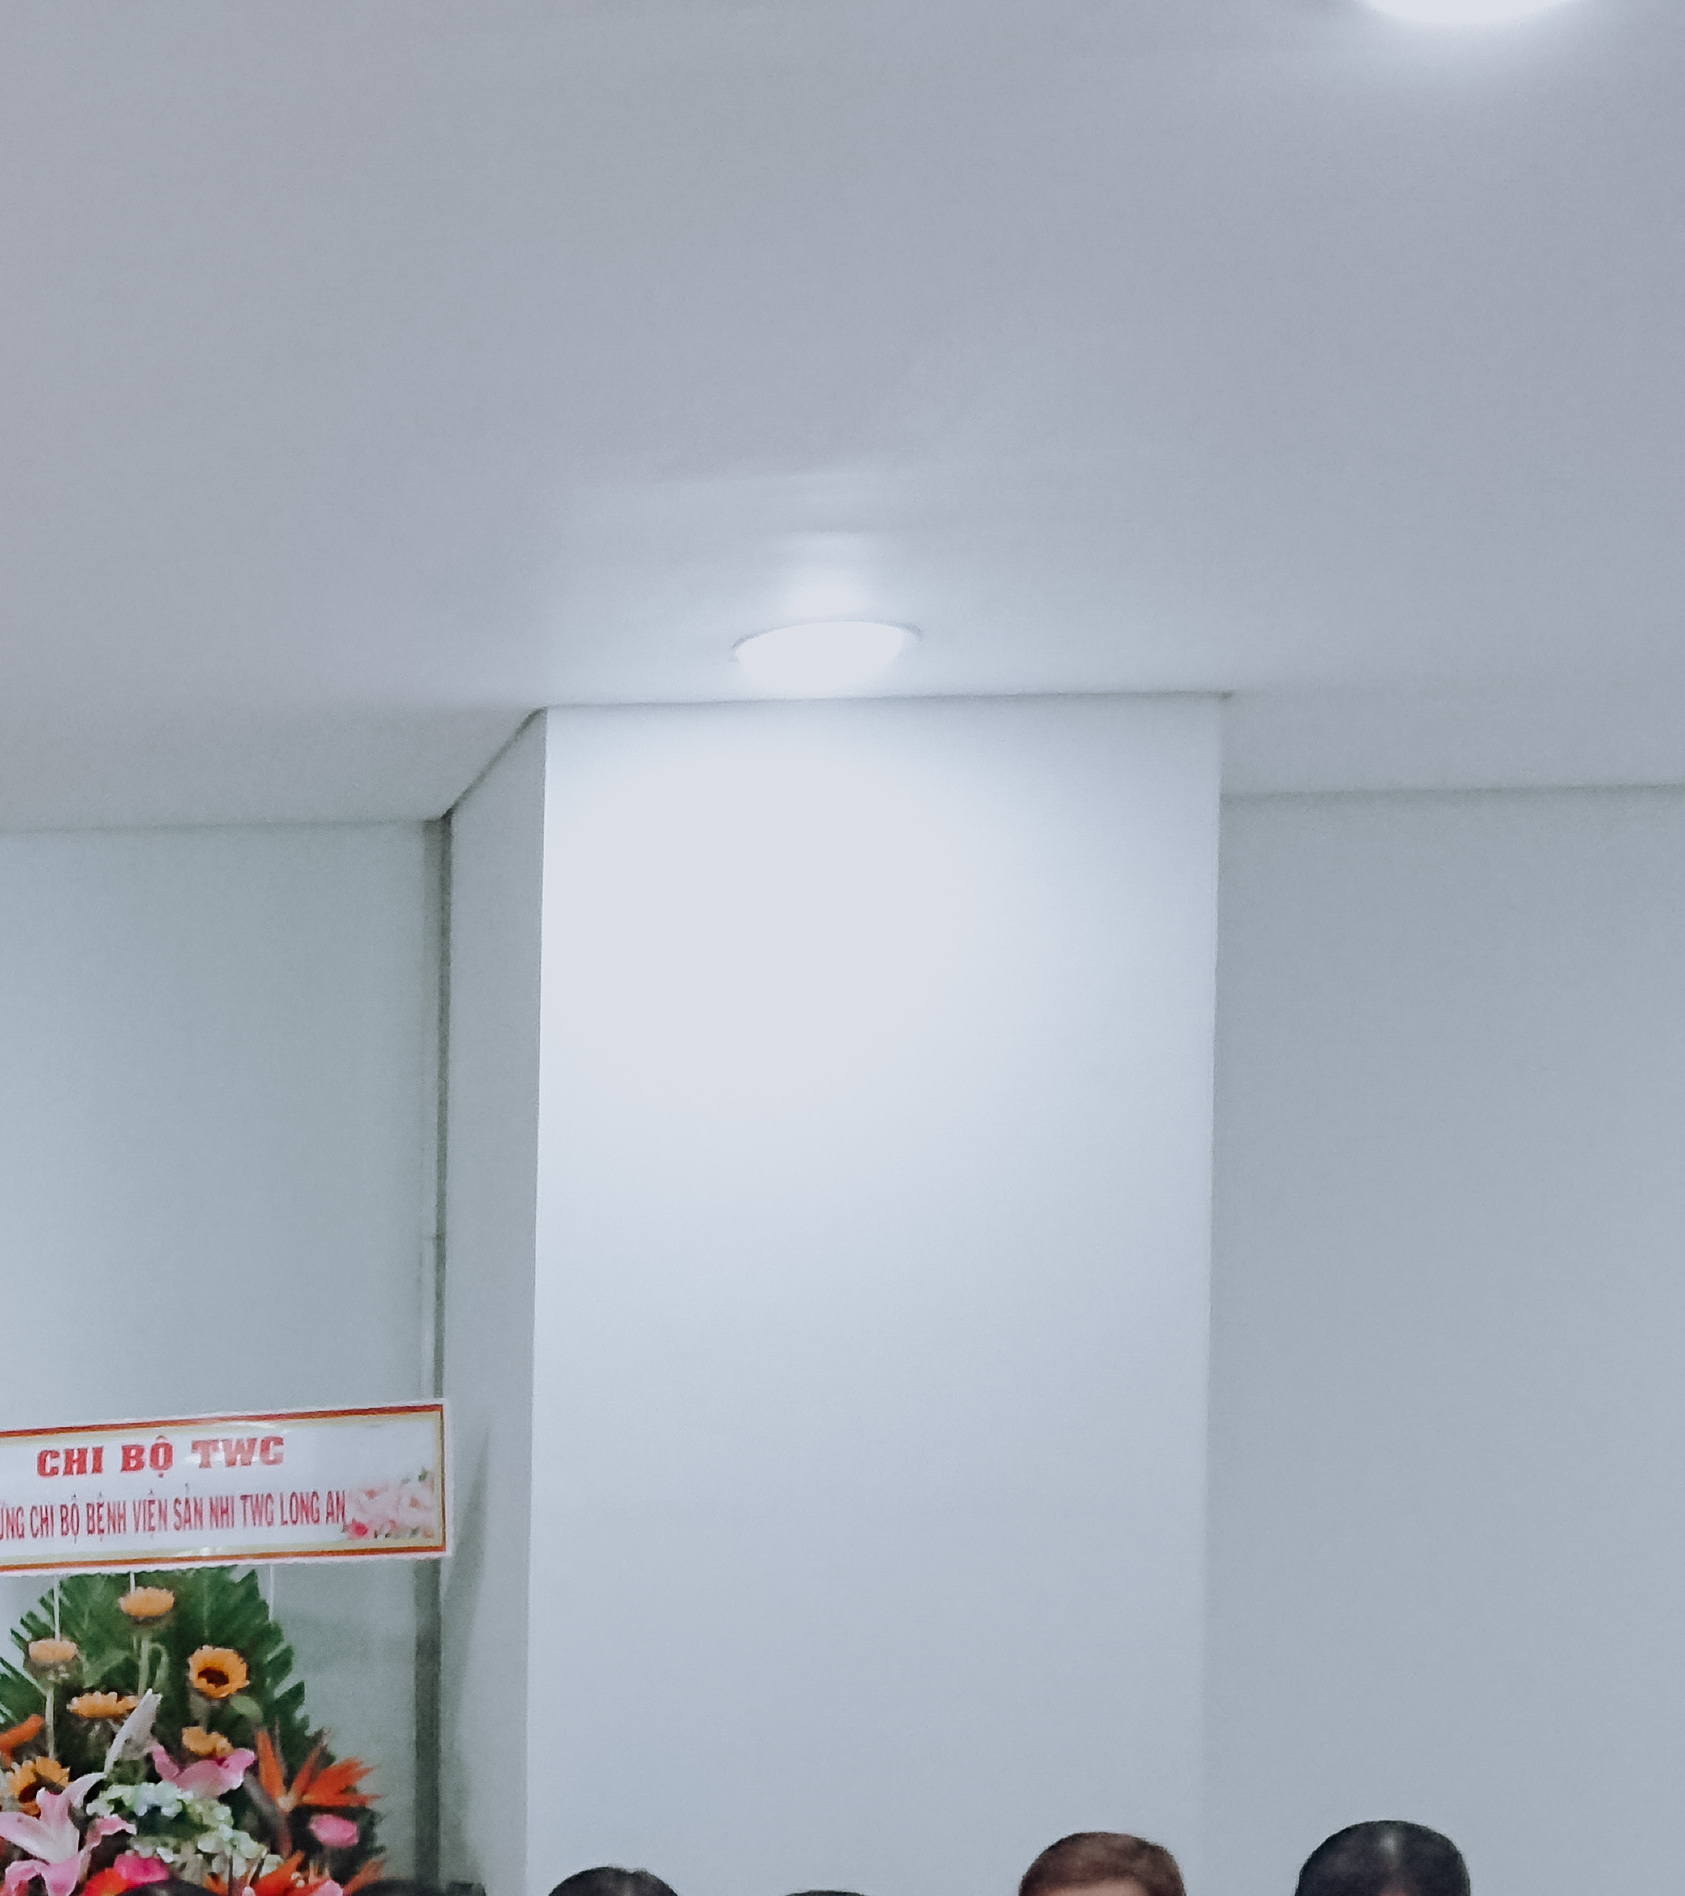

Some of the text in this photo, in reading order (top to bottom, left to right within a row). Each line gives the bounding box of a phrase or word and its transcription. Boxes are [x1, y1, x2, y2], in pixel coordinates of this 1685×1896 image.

[37, 1446, 104, 1478] CHI
[121, 1435, 173, 1478] BỘ
[30, 1503, 54, 1539] CHI
[210, 1496, 234, 1529] NHI
[240, 1493, 274, 1528] TWG
[280, 1490, 321, 1526] LONG
[326, 1490, 346, 1525] AN
